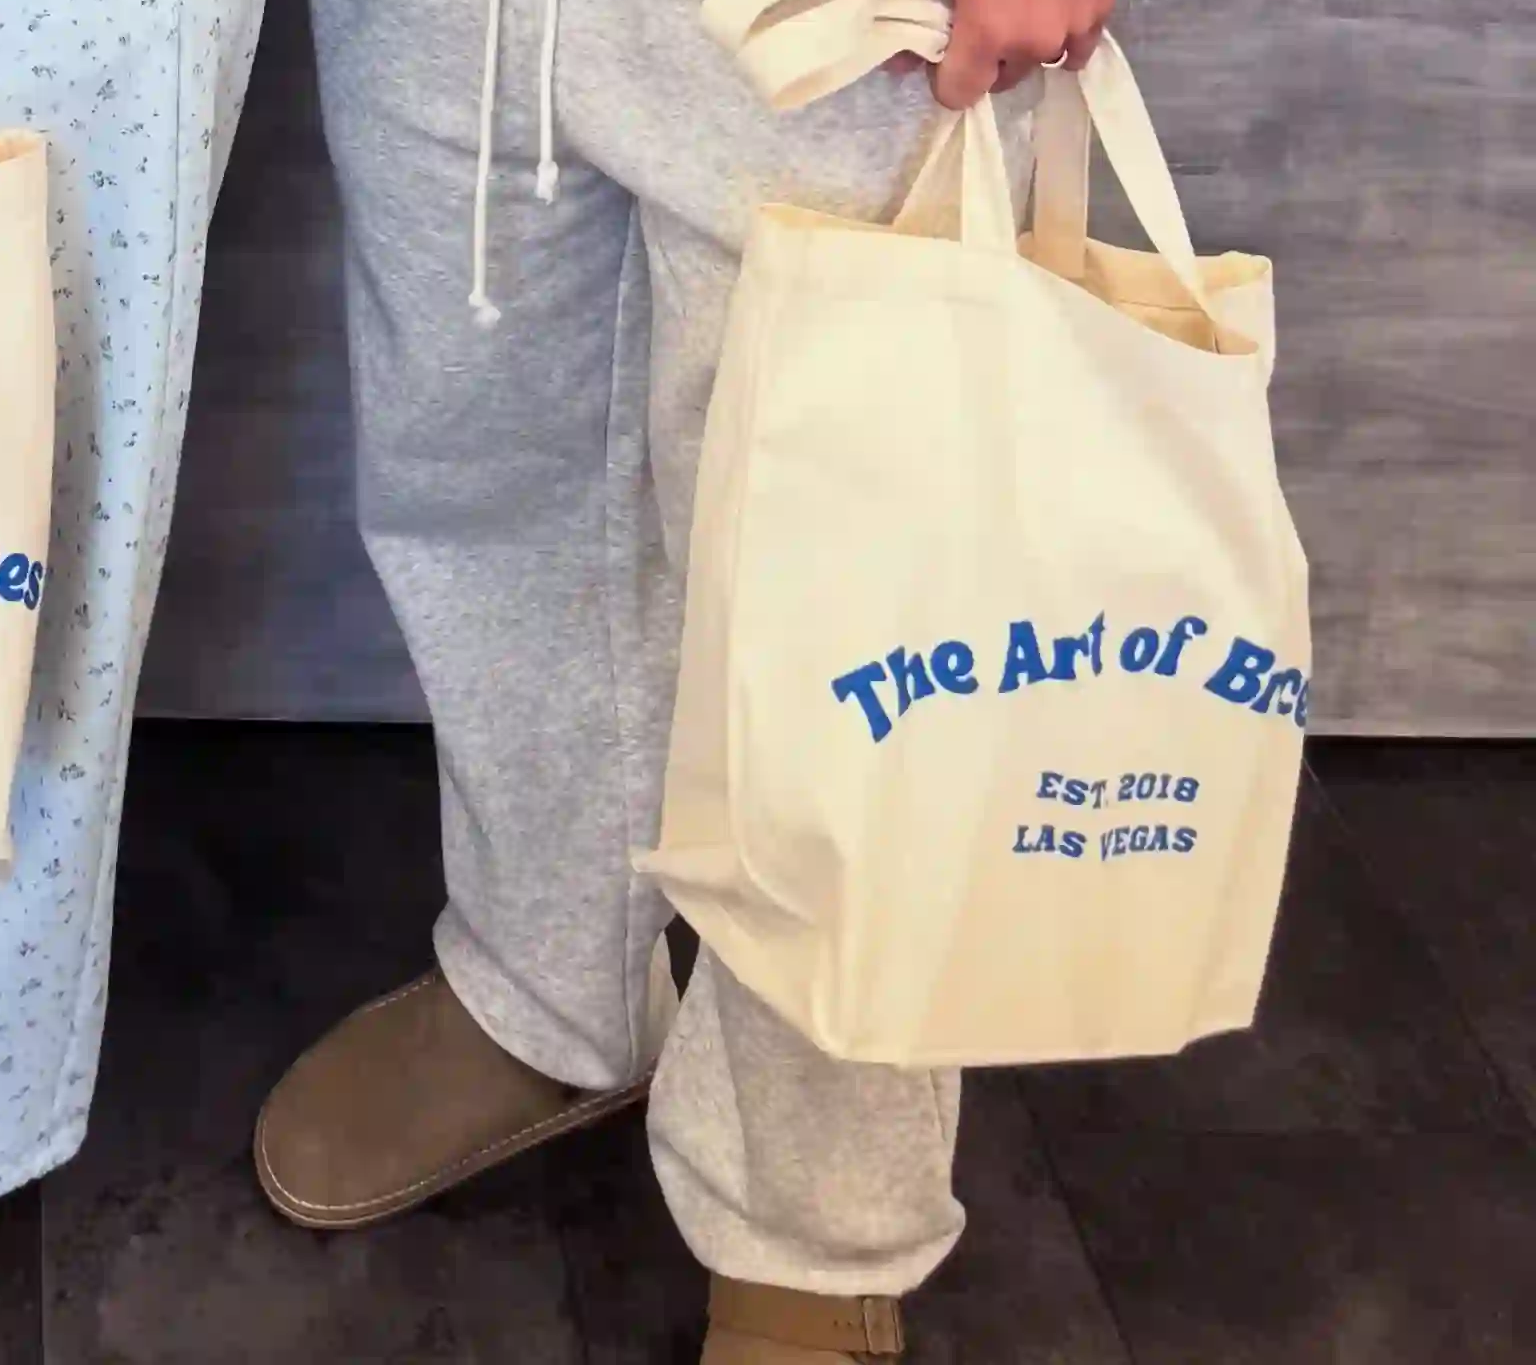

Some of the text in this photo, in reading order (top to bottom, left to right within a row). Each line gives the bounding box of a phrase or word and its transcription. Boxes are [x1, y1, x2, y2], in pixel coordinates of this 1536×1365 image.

[830, 639, 980, 744] The
[996, 610, 1106, 695] Art
[1118, 614, 1208, 678] of
[1117, 772, 1201, 803] 2018
[1012, 824, 1199, 862] LAS VEGAS
